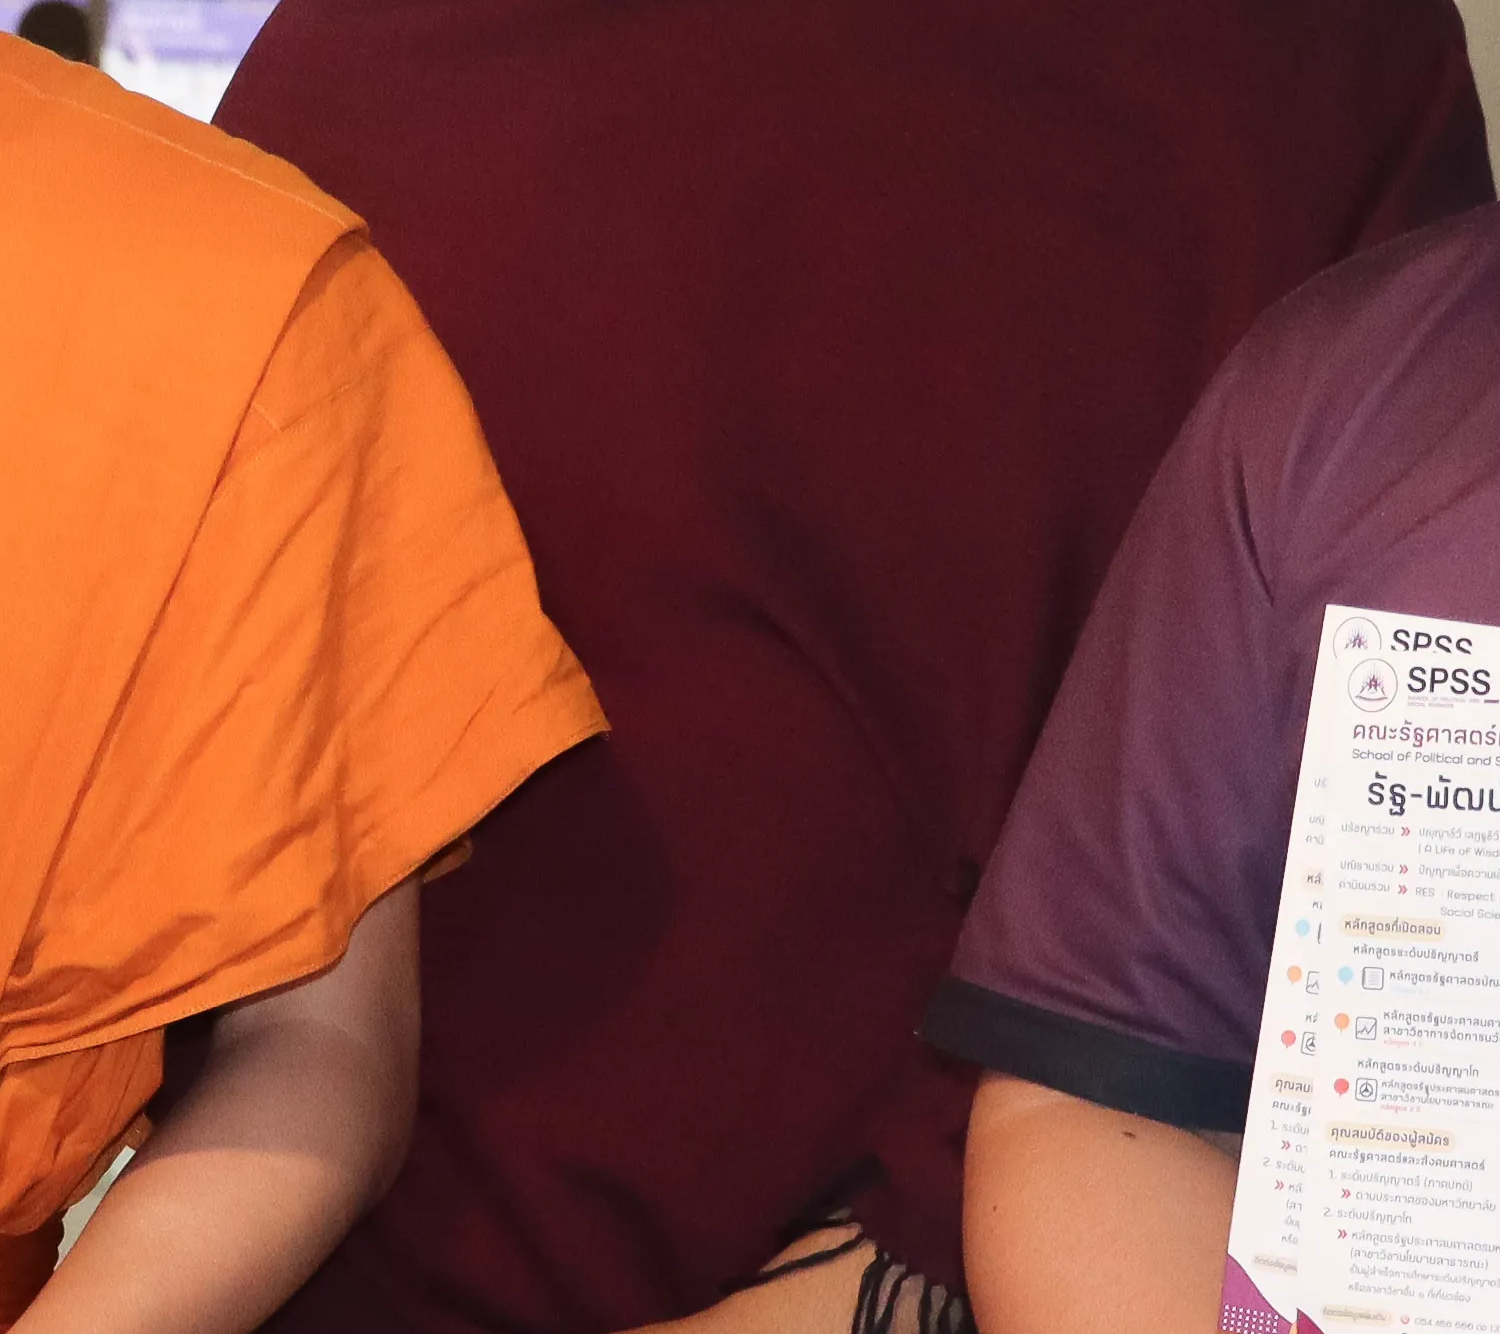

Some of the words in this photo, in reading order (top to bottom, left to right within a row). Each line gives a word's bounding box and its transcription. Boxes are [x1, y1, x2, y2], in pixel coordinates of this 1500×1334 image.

[1407, 666, 1492, 696] SPSS
[1352, 748, 1394, 761] School
[1415, 751, 1463, 765] Political
[1467, 754, 1492, 766] and
[1416, 887, 1435, 897] RES
[1447, 890, 1494, 901] Respect
[1441, 907, 1474, 917] Social
